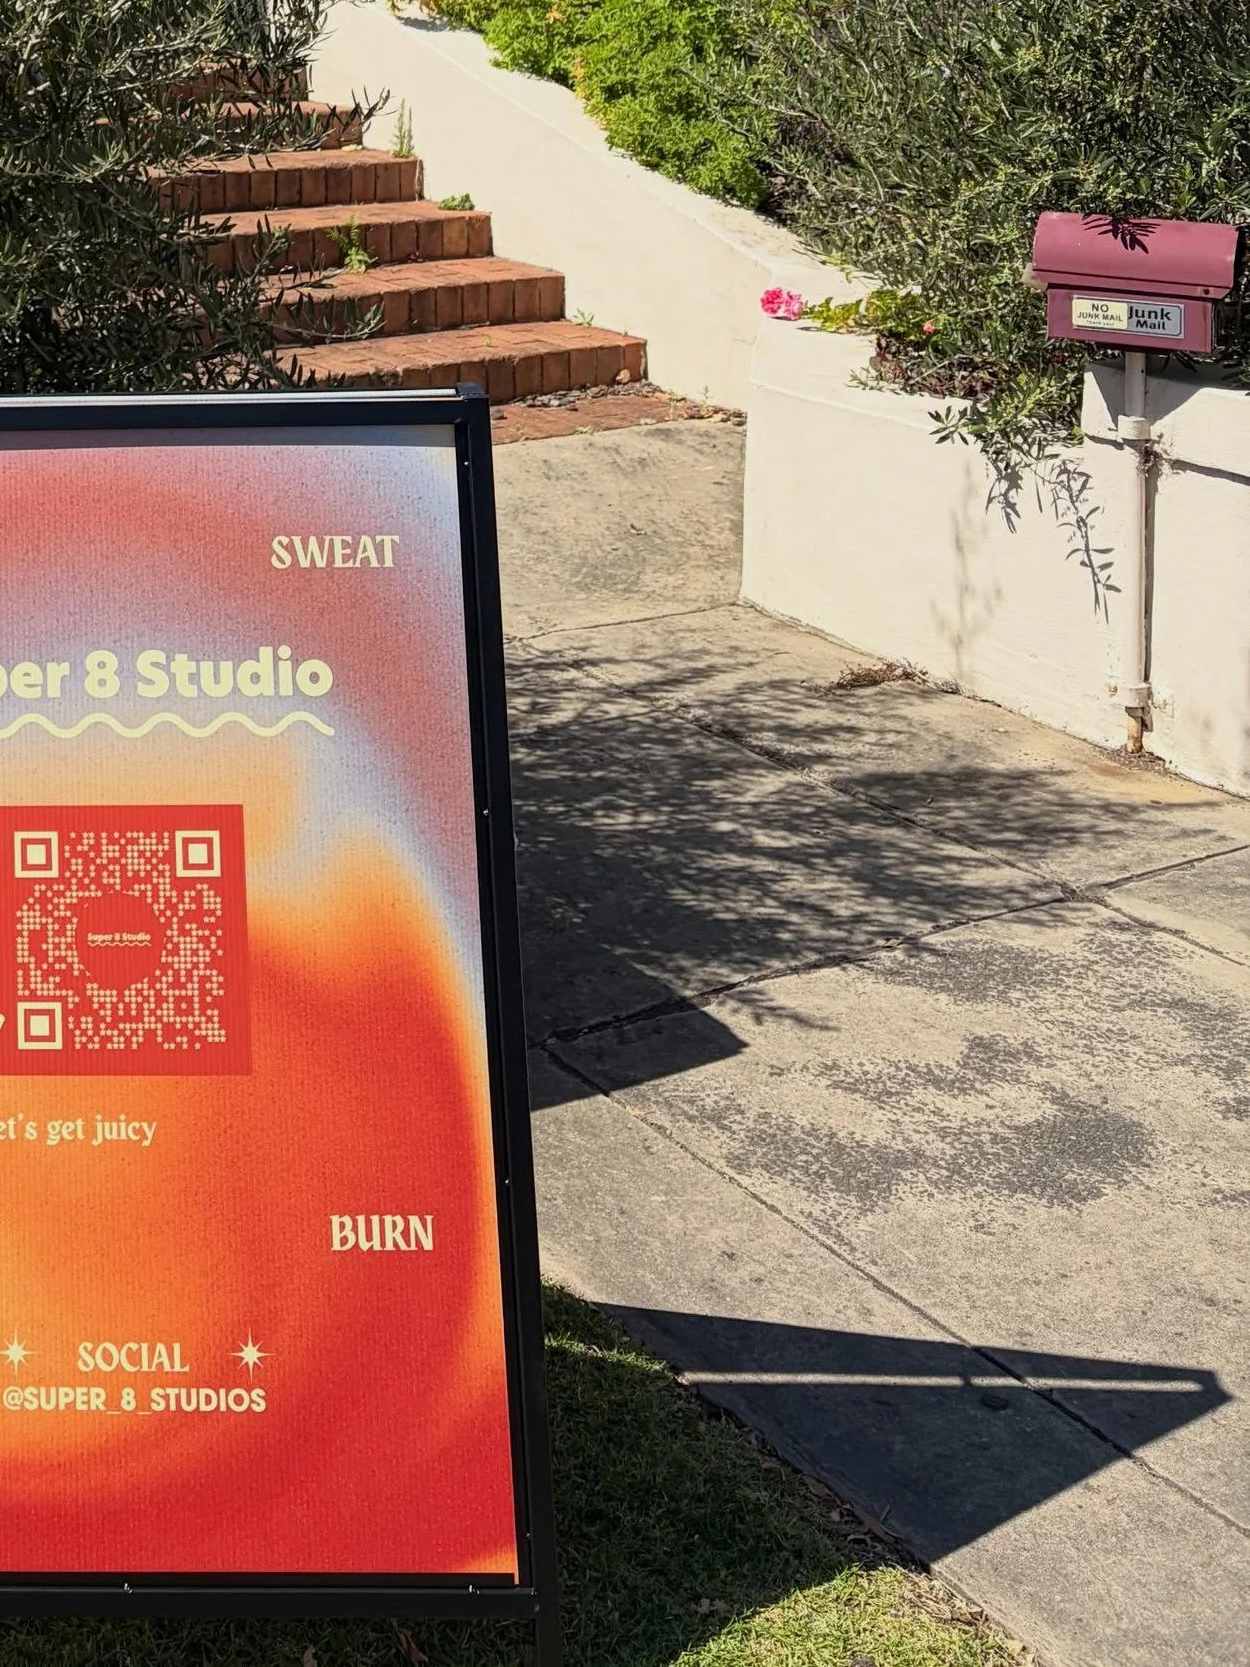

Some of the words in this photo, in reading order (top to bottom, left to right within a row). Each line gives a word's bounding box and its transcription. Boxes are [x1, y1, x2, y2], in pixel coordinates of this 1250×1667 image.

[1077, 312, 1100, 320] JUNK
[1102, 313, 1123, 322] MAIL
[1091, 303, 1109, 313] NO
[1128, 306, 1172, 321] Junk
[1136, 320, 1166, 330] Mail
[270, 535, 400, 570] SWEAT
[83, 650, 121, 699] 8
[136, 645, 334, 698] Studio
[87, 932, 113, 943] Super
[121, 932, 151, 941] Studio
[46, 1117, 86, 1146] get
[92, 1113, 158, 1147] juicy
[330, 1215, 435, 1252] BURN
[77, 1341, 190, 1373] SOCIAL
